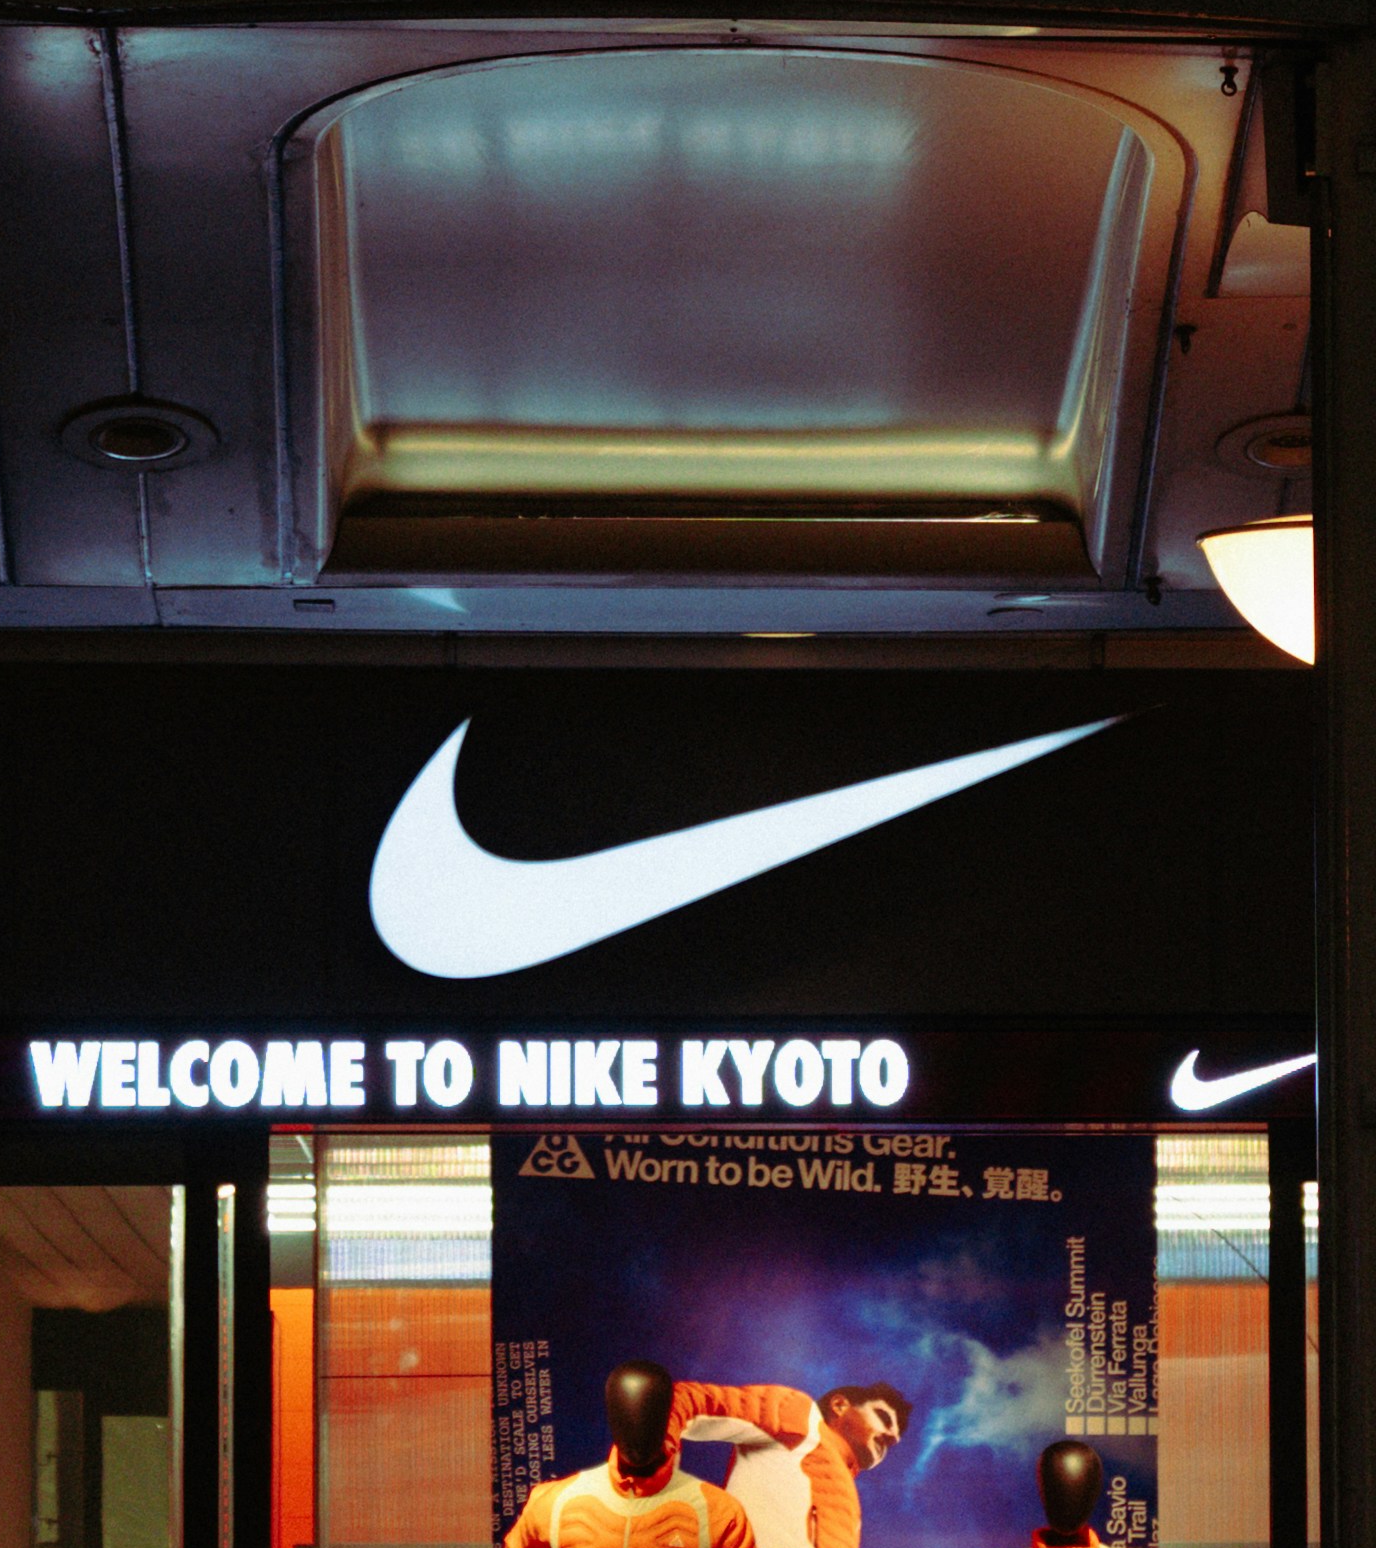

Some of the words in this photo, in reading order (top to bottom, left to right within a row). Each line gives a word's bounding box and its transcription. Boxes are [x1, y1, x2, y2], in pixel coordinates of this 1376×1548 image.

[30, 1039, 365, 1108] WELCOME
[385, 1039, 473, 1107] TO
[497, 1039, 658, 1107] NIKE
[680, 1039, 909, 1107] KYOTO
[603, 1148, 700, 1184] Worn
[705, 1154, 743, 1187] to
[747, 1155, 795, 1189] be
[796, 1157, 883, 1194] Wild.
[892, 1161, 1064, 1203] 野生、覚醒。
[1064, 1235, 1086, 1319] Summit
[508, 1341, 522, 1371] GET
[537, 1339, 550, 1359] IN
[1064, 1323, 1086, 1414] Seekofel
[1085, 1292, 1106, 1413] Dürrenstein
[1107, 1300, 1128, 1376] Ferrata
[495, 1342, 510, 1407] UNKNOWN
[510, 1379, 523, 1400] TO
[522, 1341, 539, 1424] OURSELVES
[538, 1368, 553, 1416] WATER
[1107, 1379, 1128, 1415] Via
[1127, 1324, 1152, 1415] Vallunga
[512, 1409, 526, 1456] SCALE
[541, 1424, 556, 1461] LESS
[499, 1416, 515, 1517] DESTINATION
[1106, 1475, 1128, 1536] Savio
[1127, 1500, 1148, 1544] Trail
